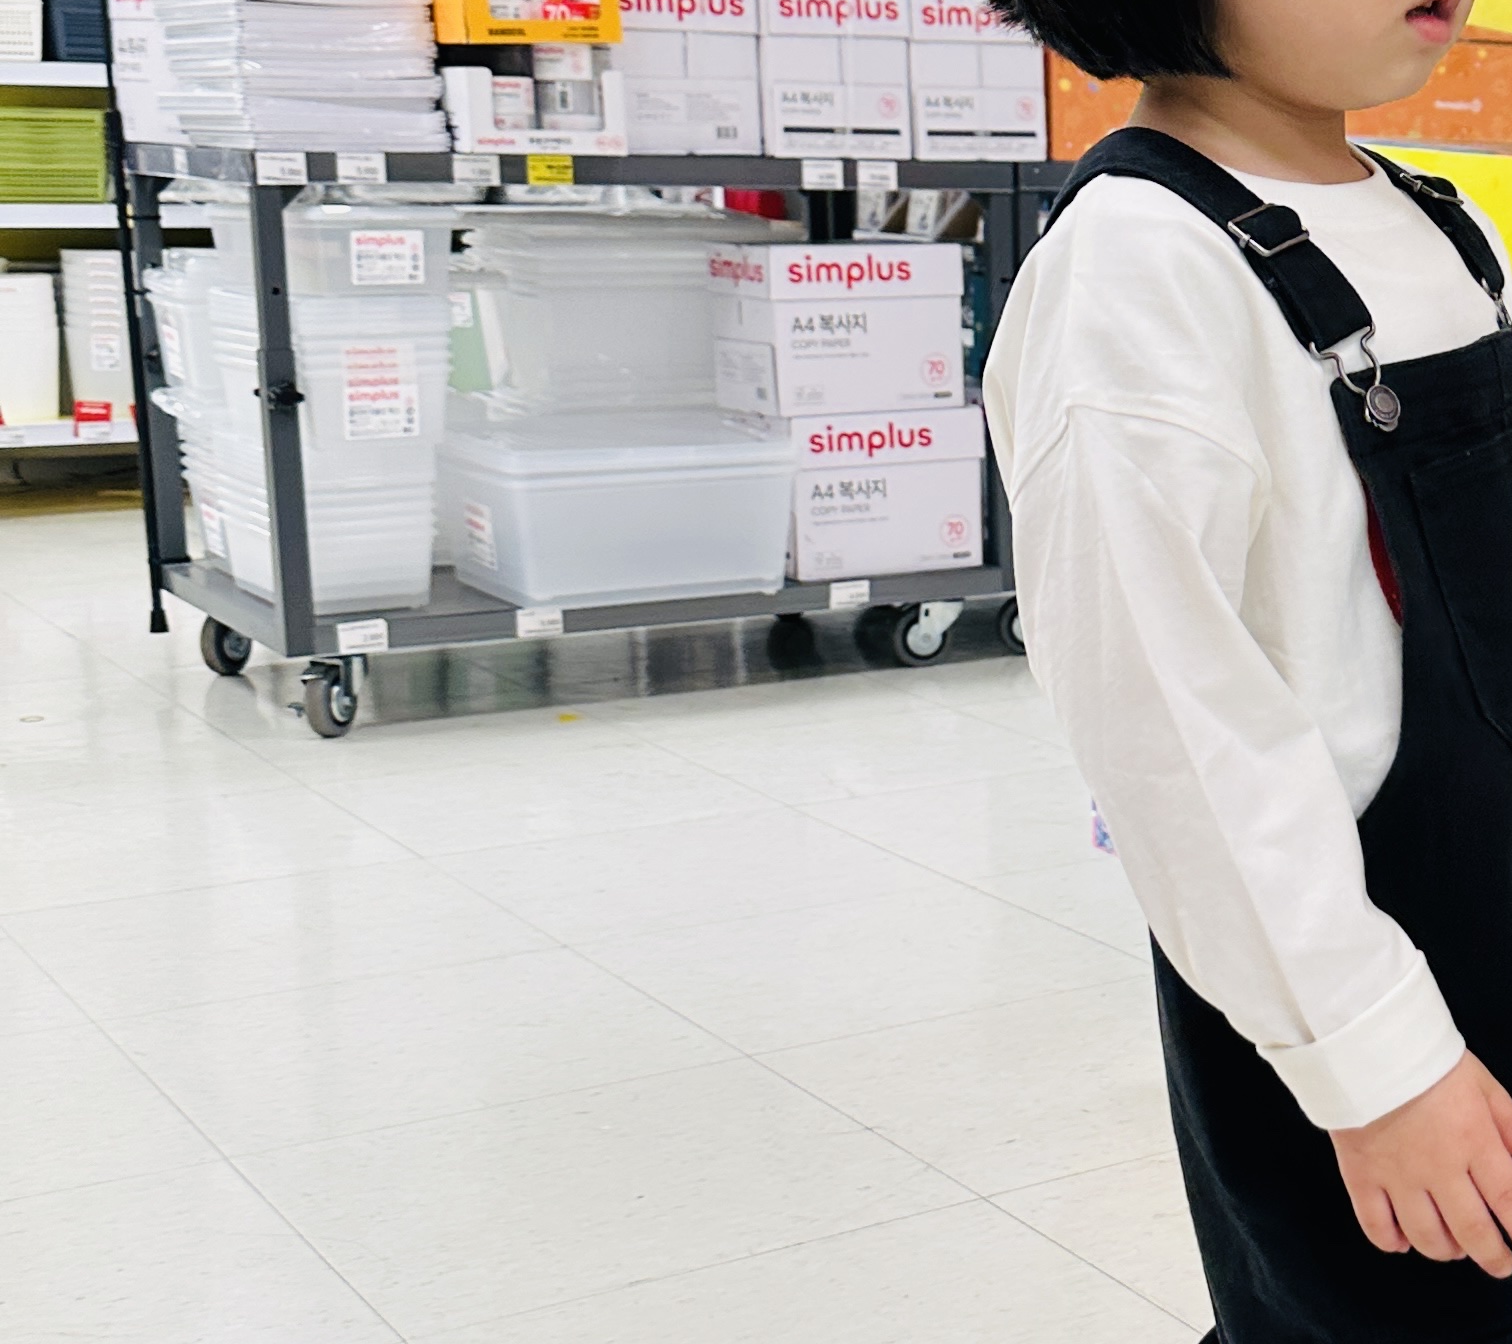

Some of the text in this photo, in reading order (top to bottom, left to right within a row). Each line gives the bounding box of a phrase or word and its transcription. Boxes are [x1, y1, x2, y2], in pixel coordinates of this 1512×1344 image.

[788, 253, 912, 290] simplus
[792, 311, 868, 336] A4 복사지
[809, 421, 933, 458] simplus
[811, 478, 888, 502] A4 복사지
